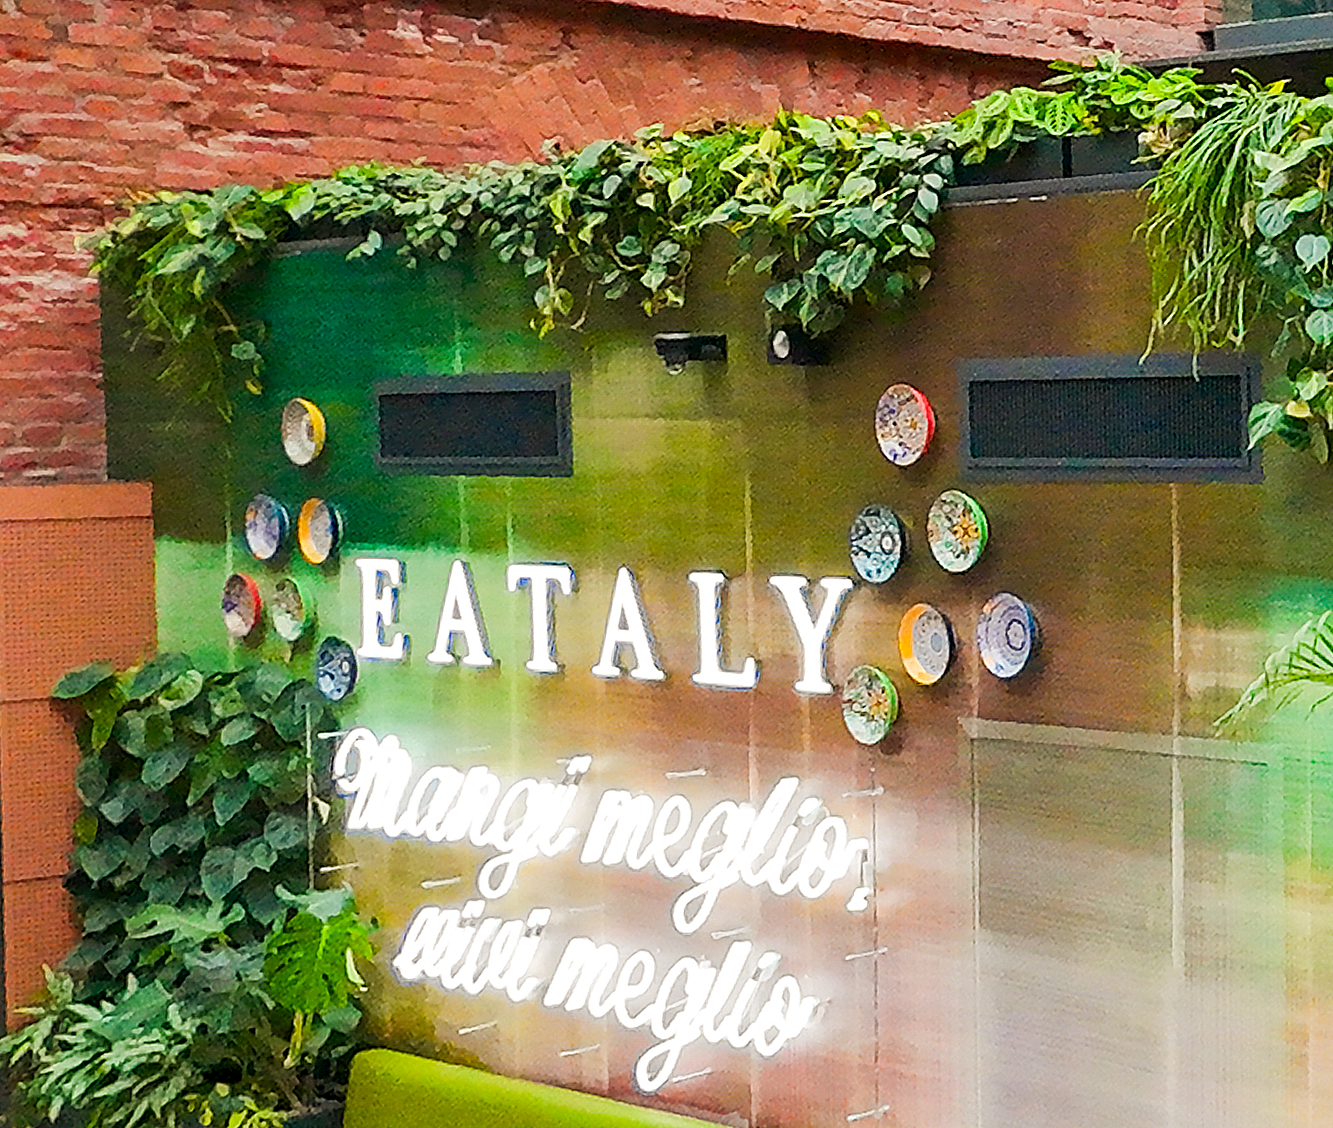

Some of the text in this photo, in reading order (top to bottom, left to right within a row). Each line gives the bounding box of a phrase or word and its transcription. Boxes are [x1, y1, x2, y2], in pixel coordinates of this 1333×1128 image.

[355, 557, 855, 696] EATALY
[331, 726, 593, 899] Mangi
[543, 938, 818, 1096] meglio
